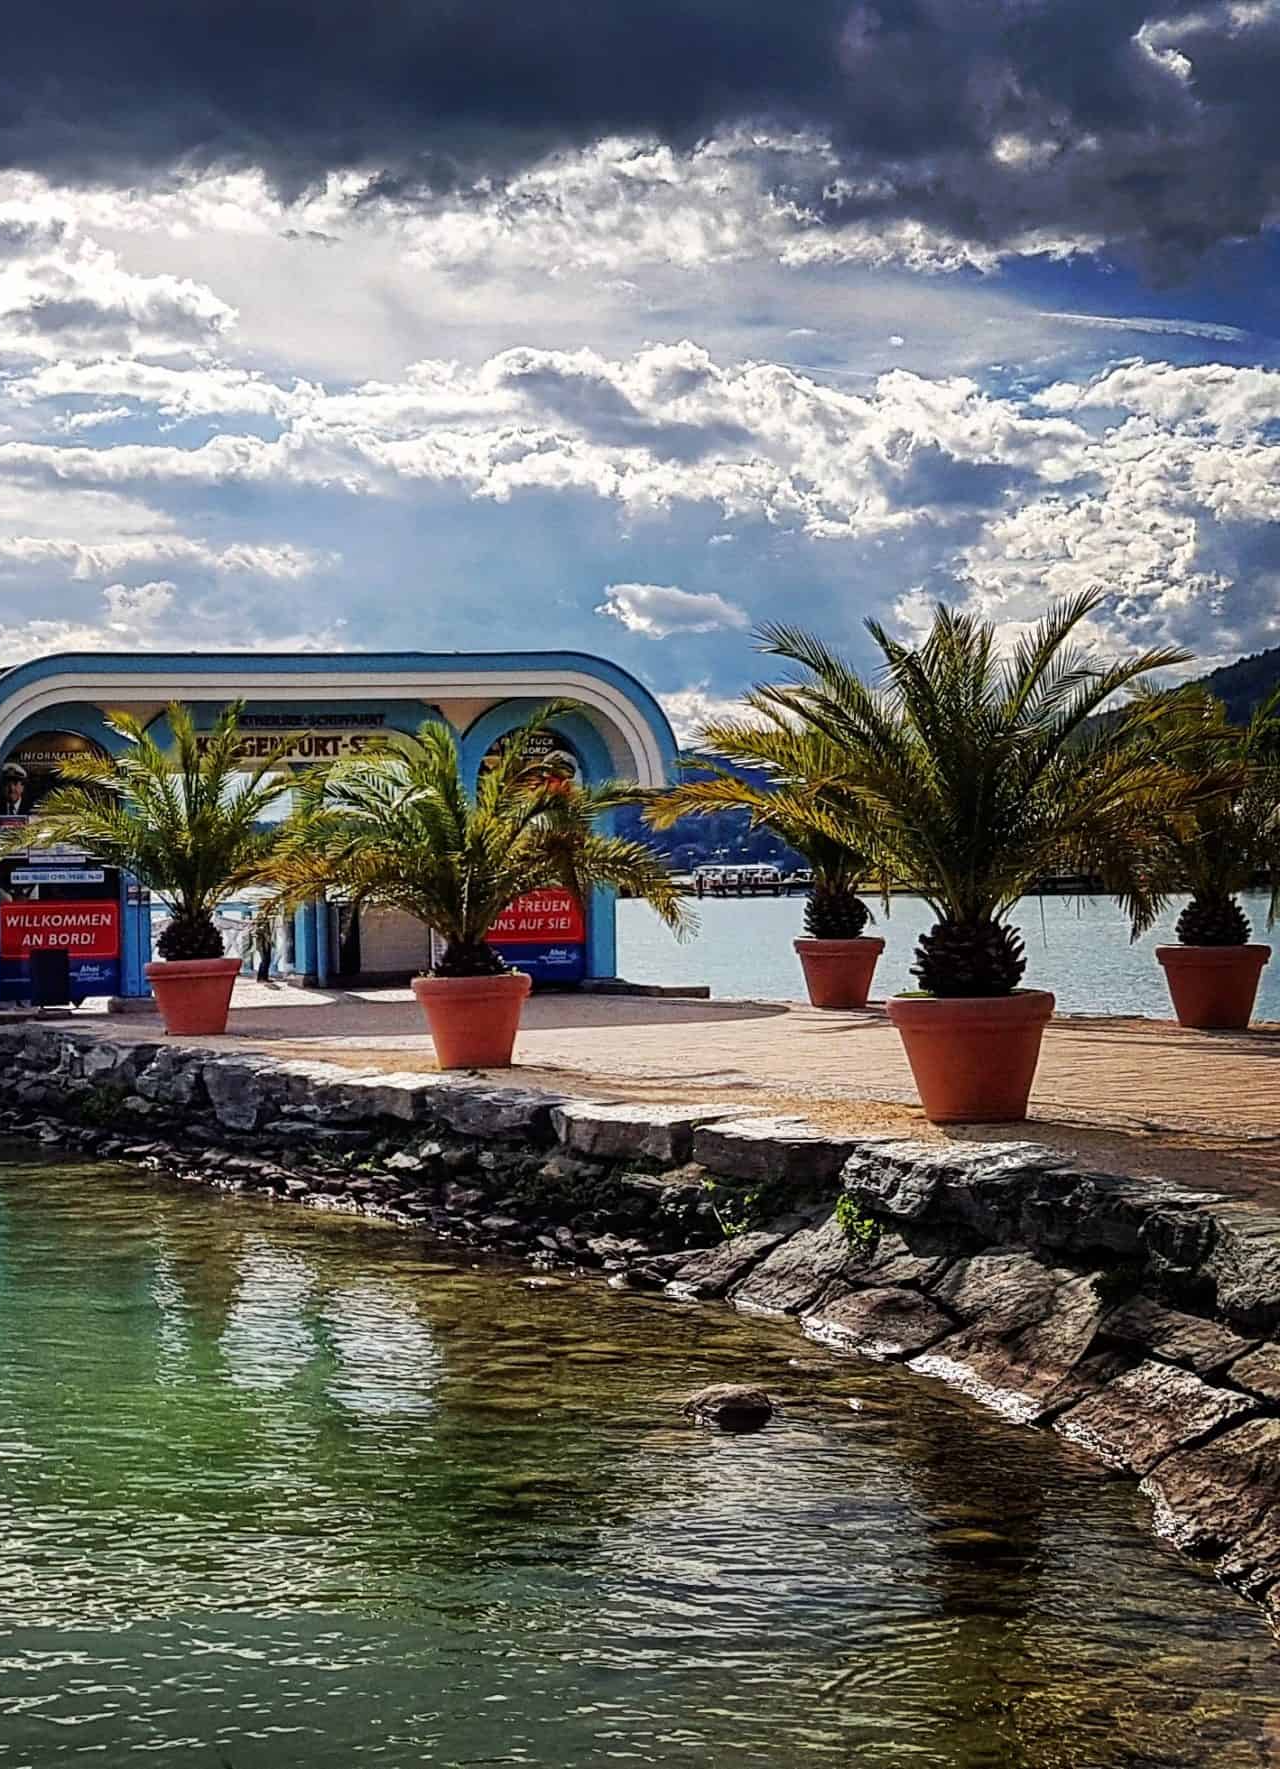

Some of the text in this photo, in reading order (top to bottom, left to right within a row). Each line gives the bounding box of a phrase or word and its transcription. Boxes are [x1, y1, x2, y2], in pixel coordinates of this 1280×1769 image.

[518, 900, 571, 913] FREUEN
[6, 914, 112, 927] WILLKOMMEN
[519, 918, 545, 930] AUF
[548, 917, 571, 929] SIE!
[22, 932, 96, 946] AN BORD!
